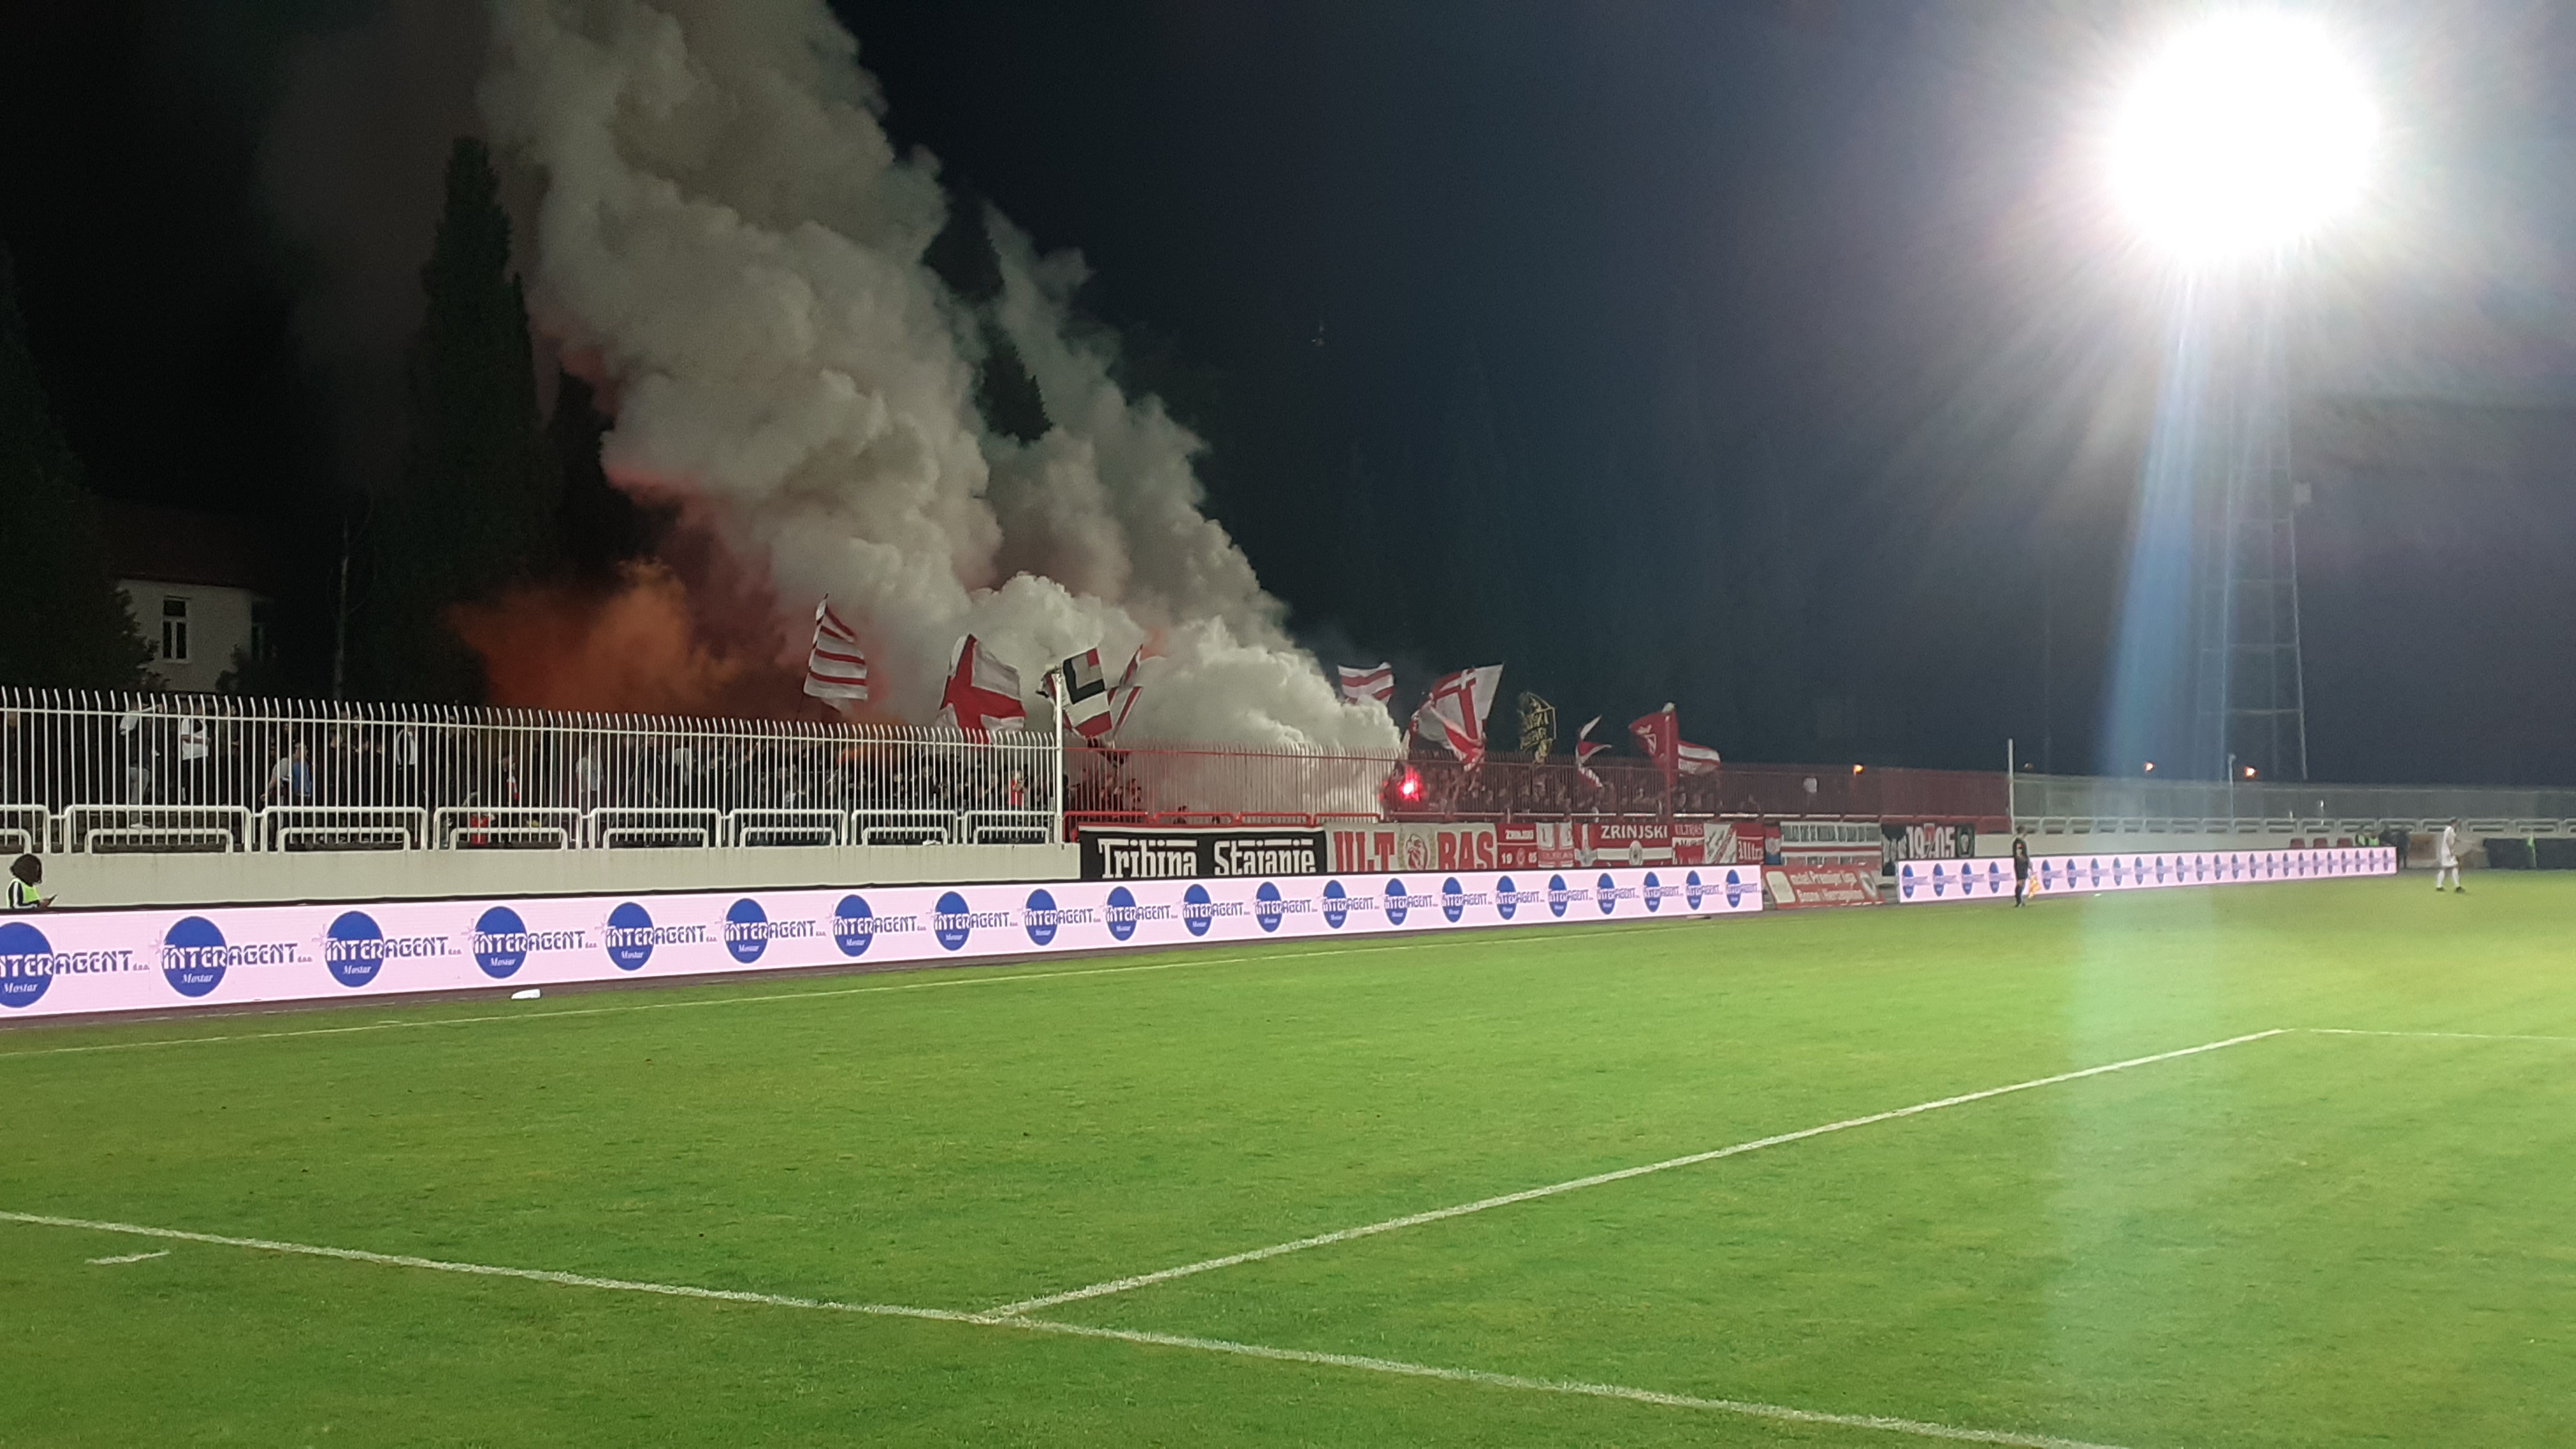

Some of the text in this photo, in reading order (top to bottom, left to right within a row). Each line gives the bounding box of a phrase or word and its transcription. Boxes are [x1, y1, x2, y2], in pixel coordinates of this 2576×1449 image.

[1601, 824, 1668, 839] ZRINJSKI
[1098, 838, 1198, 879] Tribina
[1437, 831, 1494, 870] RAS
[606, 925, 706, 947] INTERAGENT
[724, 920, 816, 942] INTERAGENT
[834, 915, 917, 935] INTERAGENT
[325, 936, 449, 962] INTERAGENT
[474, 930, 585, 954] INTERAGENT
[162, 943, 298, 970] INTERAGENT
[180, 973, 214, 984] Mostar
